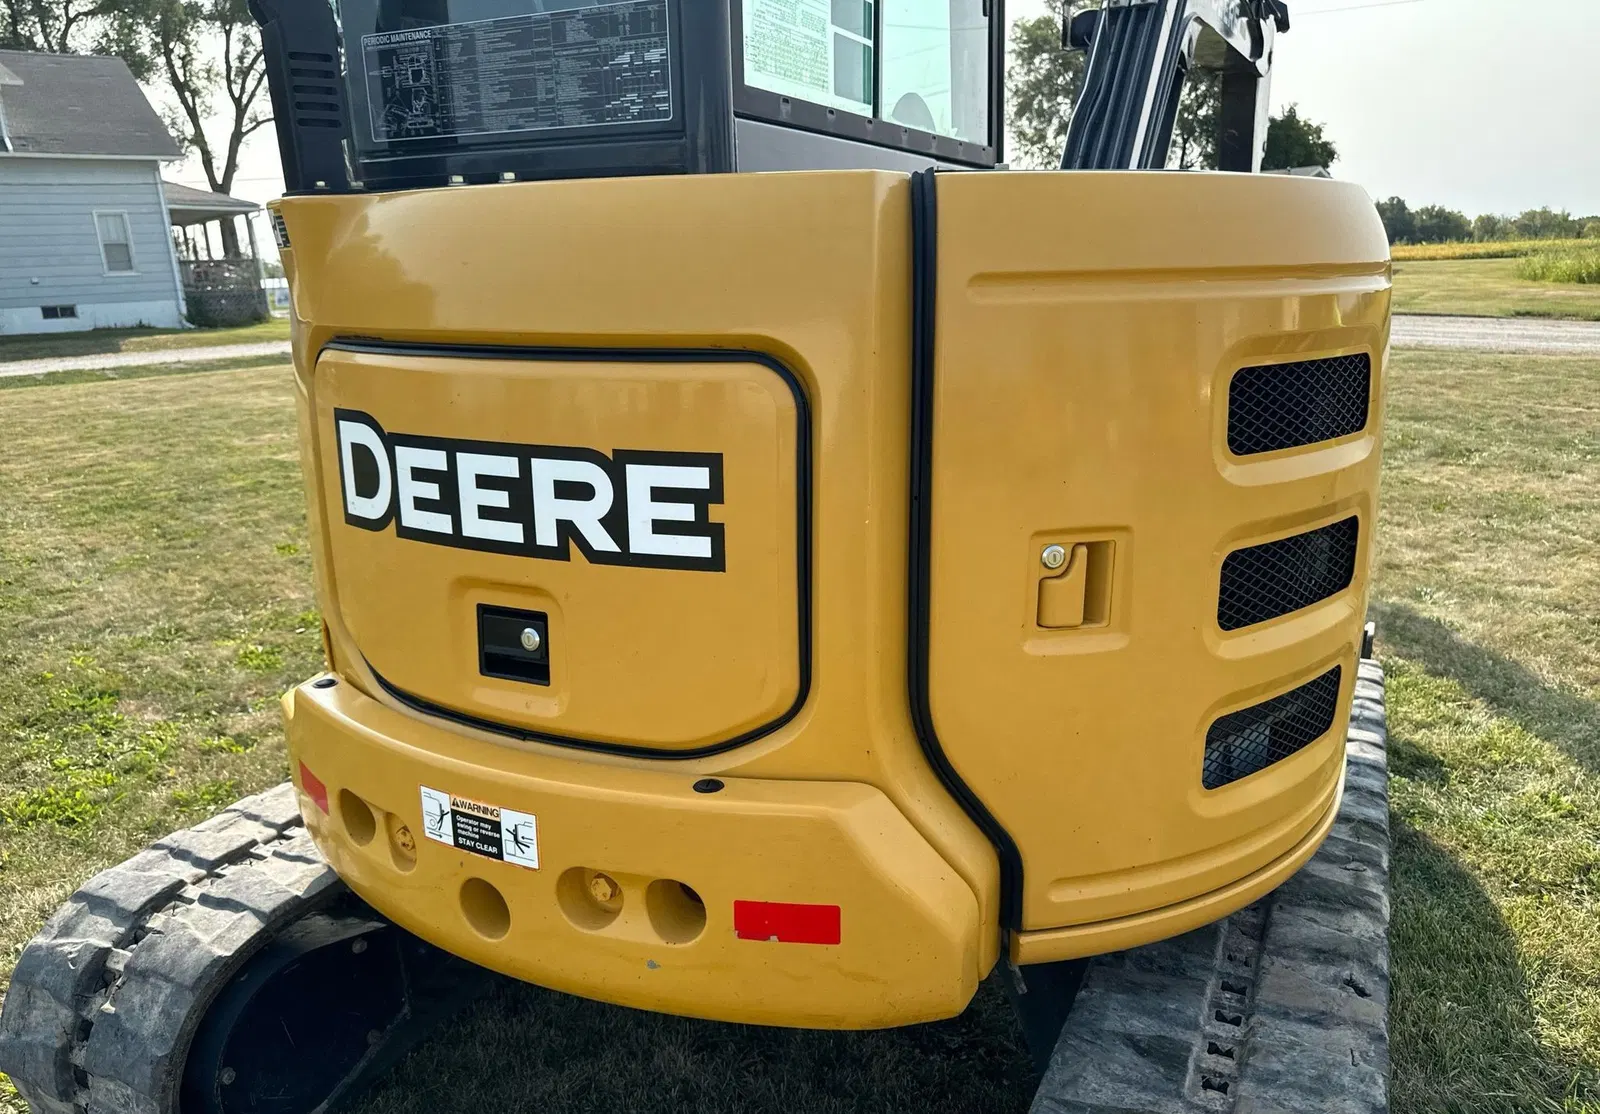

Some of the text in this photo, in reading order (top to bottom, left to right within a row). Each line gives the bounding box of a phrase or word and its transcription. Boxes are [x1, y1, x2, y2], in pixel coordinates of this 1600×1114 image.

[364, 35, 390, 46] PERIODIC
[391, 30, 432, 42] MAINTENANCE
[338, 420, 713, 558] DEERE
[459, 800, 499, 817] WARNING
[456, 815, 491, 830] Operator may
[457, 829, 479, 839] machine
[480, 829, 500, 838] reverse
[458, 837, 498, 854] STAY CLEAR
